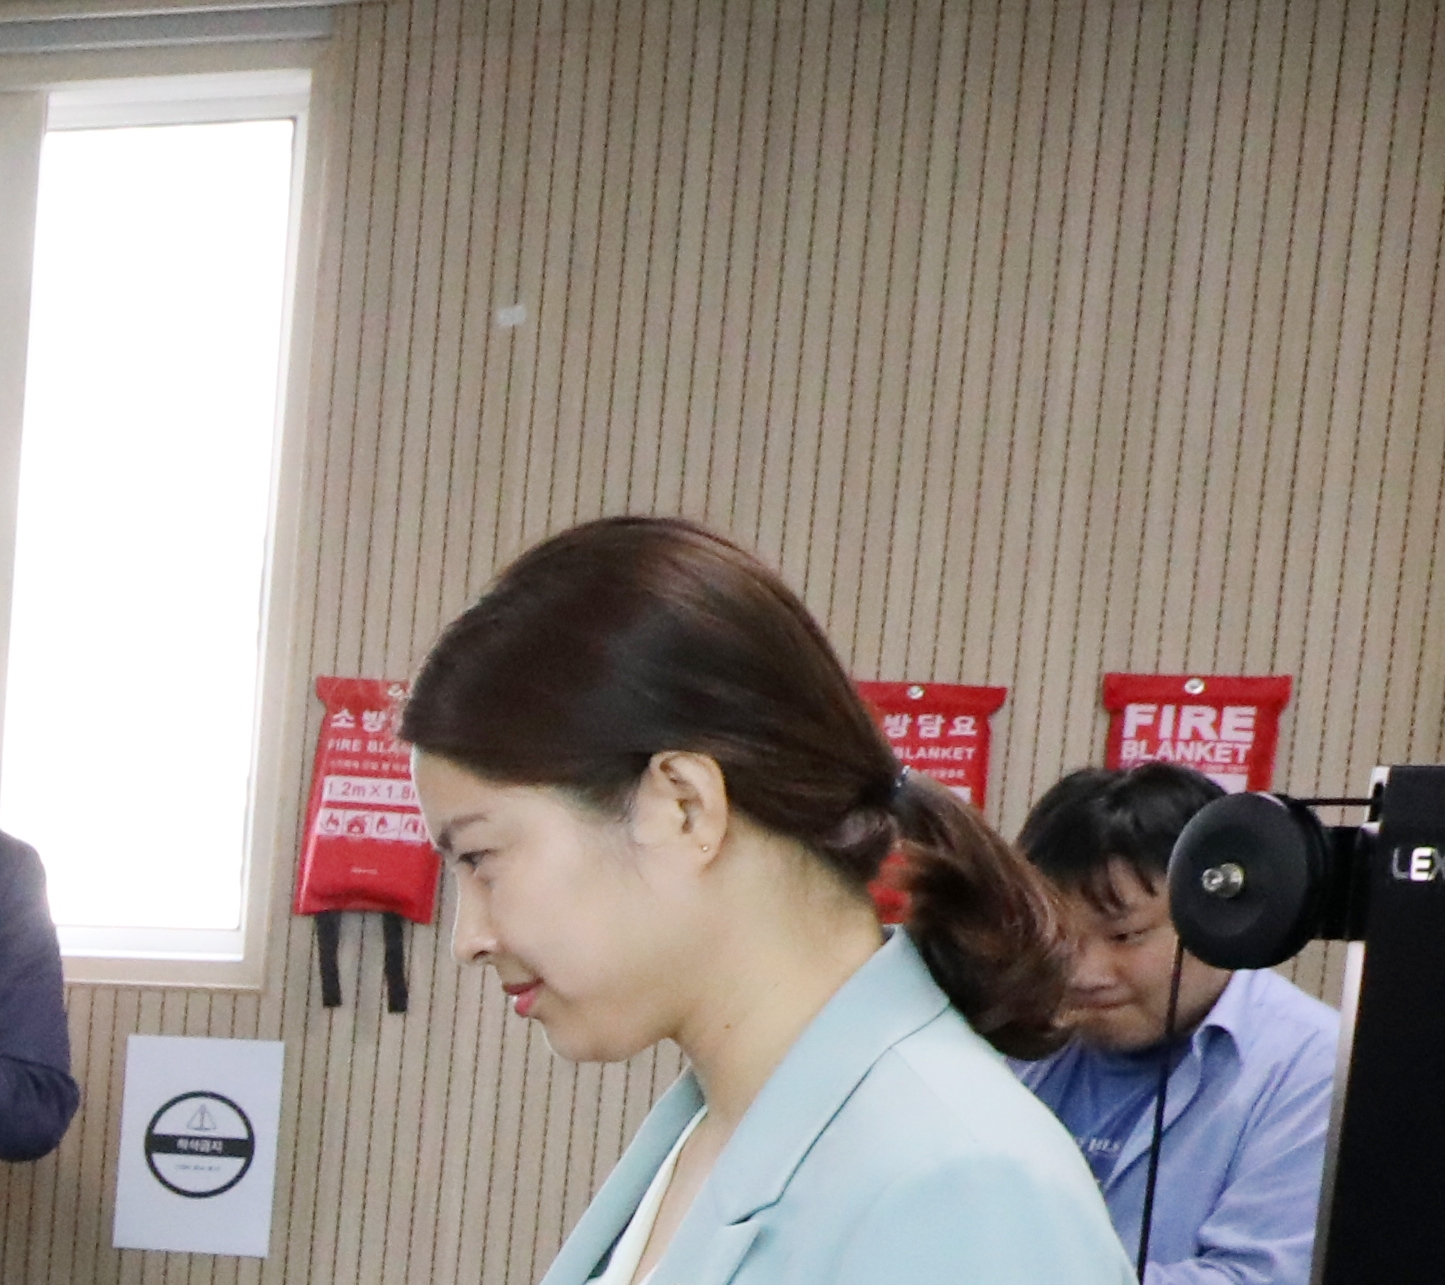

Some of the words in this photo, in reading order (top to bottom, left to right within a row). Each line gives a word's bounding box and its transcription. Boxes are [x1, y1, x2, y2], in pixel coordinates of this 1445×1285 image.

[884, 713, 978, 739] 방담요
[1122, 702, 1258, 743] FIRE
[327, 738, 362, 754] FIRE
[1120, 739, 1253, 764] BLANKET
